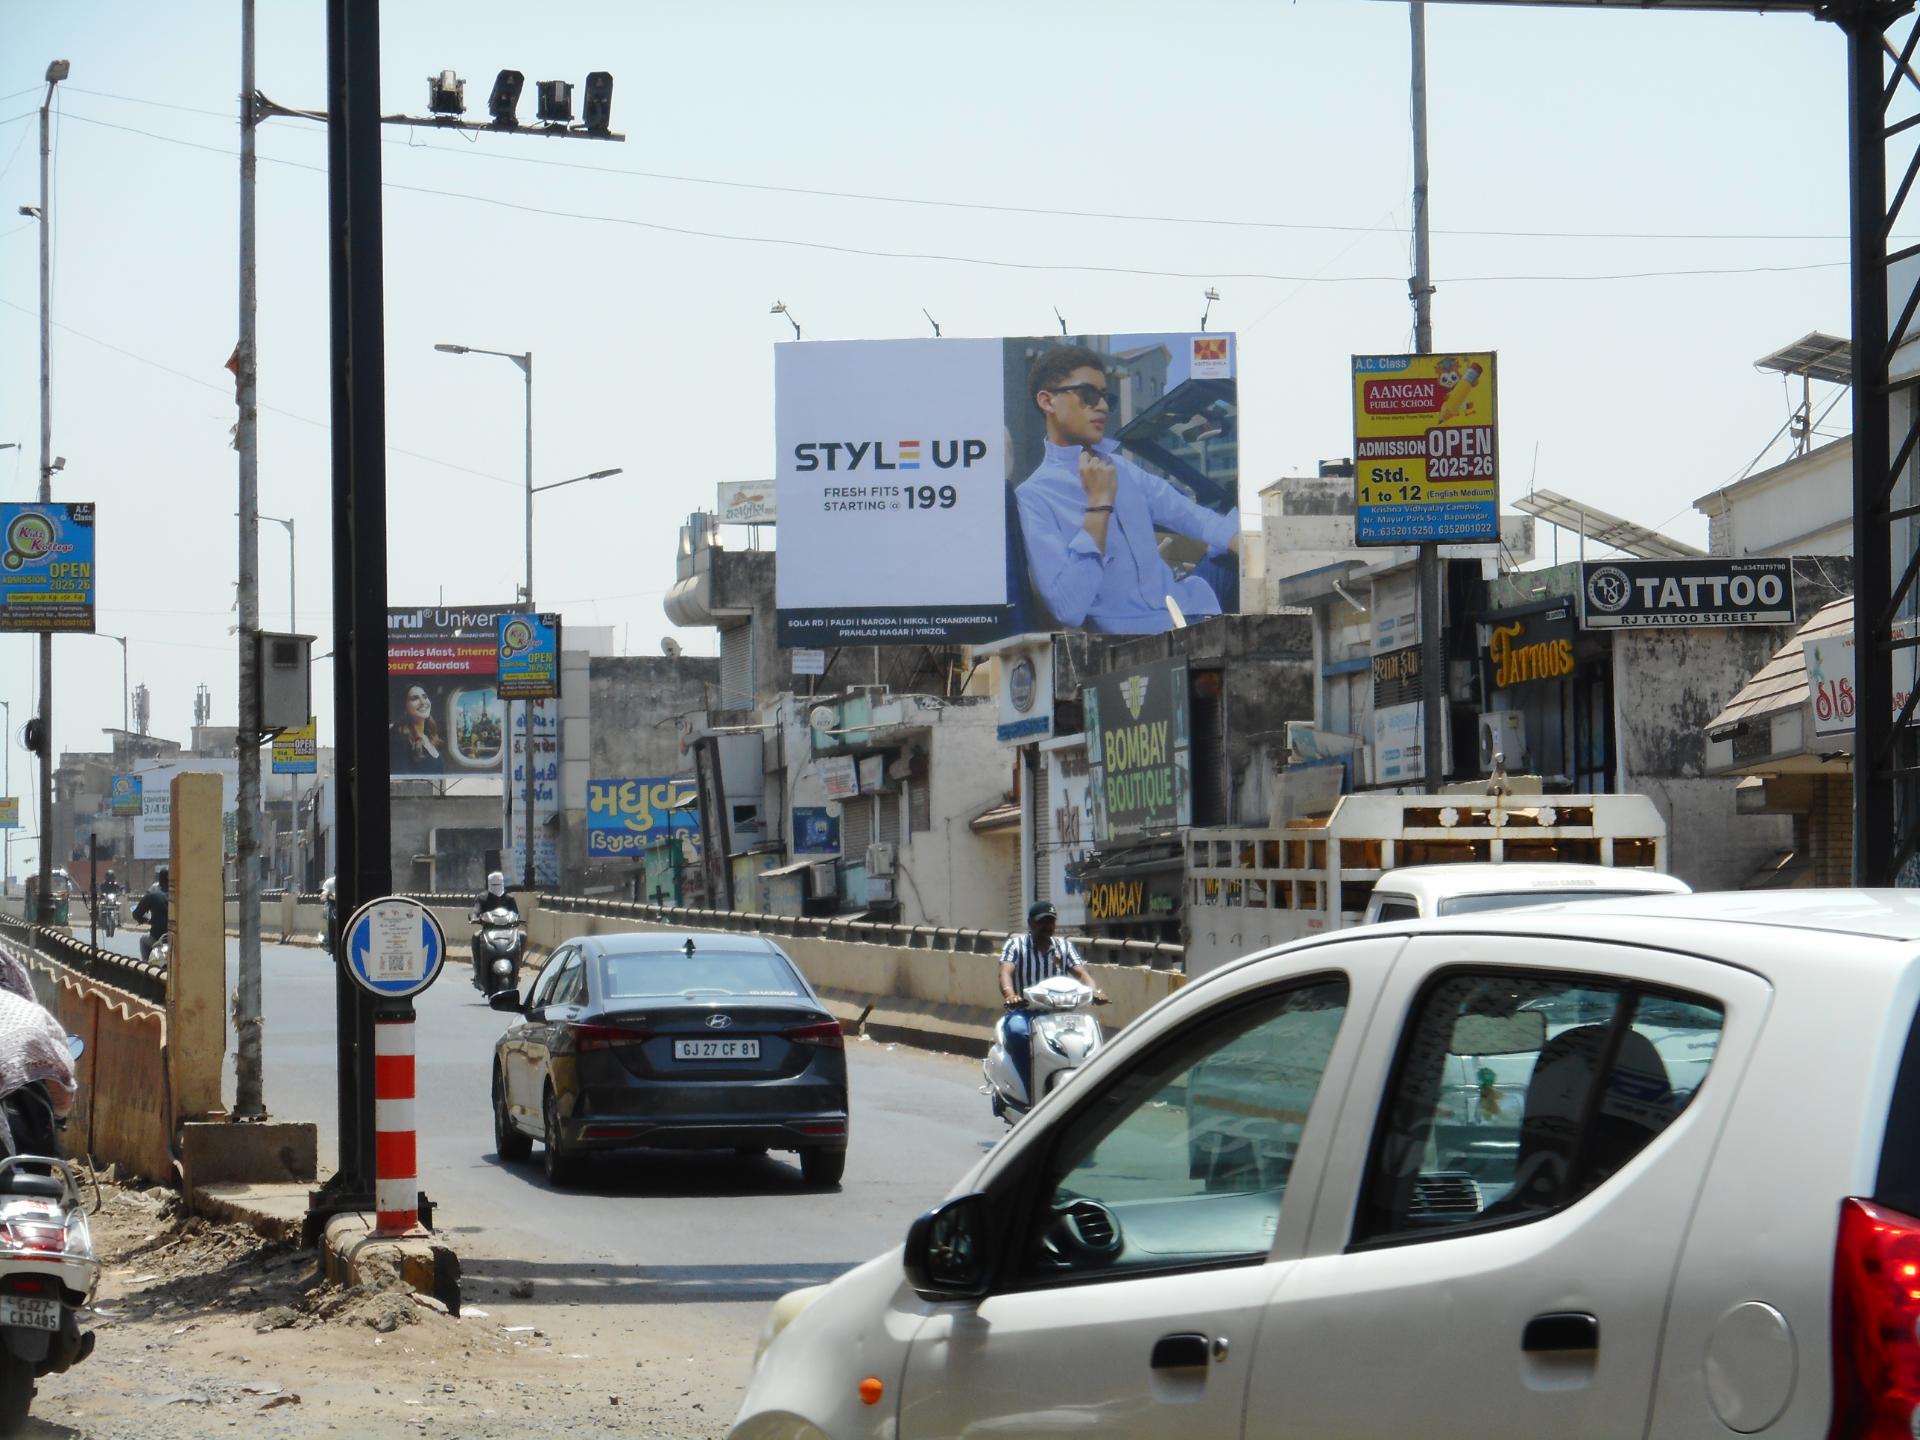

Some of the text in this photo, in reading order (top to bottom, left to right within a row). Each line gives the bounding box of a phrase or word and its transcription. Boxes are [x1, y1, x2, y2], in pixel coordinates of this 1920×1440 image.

[1356, 357, 1407, 370] A.C. Class
[1370, 384, 1434, 399] AANGAN
[1370, 400, 1435, 409] PUBLIC SCHOOL
[1358, 440, 1426, 457] ADMISSION
[1429, 429, 1491, 457] OPEN
[795, 439, 987, 472] STYLE UP
[1429, 457, 1493, 478] 2025-26
[1371, 468, 1409, 483] Std.
[824, 486, 900, 498] FRESH FITS
[903, 485, 957, 510] 199
[1361, 486, 1421, 502] 1 to 12
[1427, 488, 1494, 500] (English Medium)
[824, 500, 887, 512] STARTING
[50, 562, 91, 578] OPEN
[1636, 574, 1783, 609] TATTOO
[812, 619, 824, 627] RD
[861, 618, 897, 626] NARODA
[935, 616, 993, 625] CHANDKHEDA
[1621, 612, 1758, 625] RJ TATTOO STREET
[839, 627, 947, 637] PRAHLAD NAGAR VINZOL
[456, 647, 498, 657] Interna
[528, 653, 553, 664] OPEN
[416, 661, 470, 670] Zabardast
[1105, 720, 1168, 773] BOMBAY
[1107, 767, 1173, 816] BOUTIQUE
[1091, 881, 1144, 920] BOMBAY
[683, 1042, 757, 1056] GJ 27 CF 81
